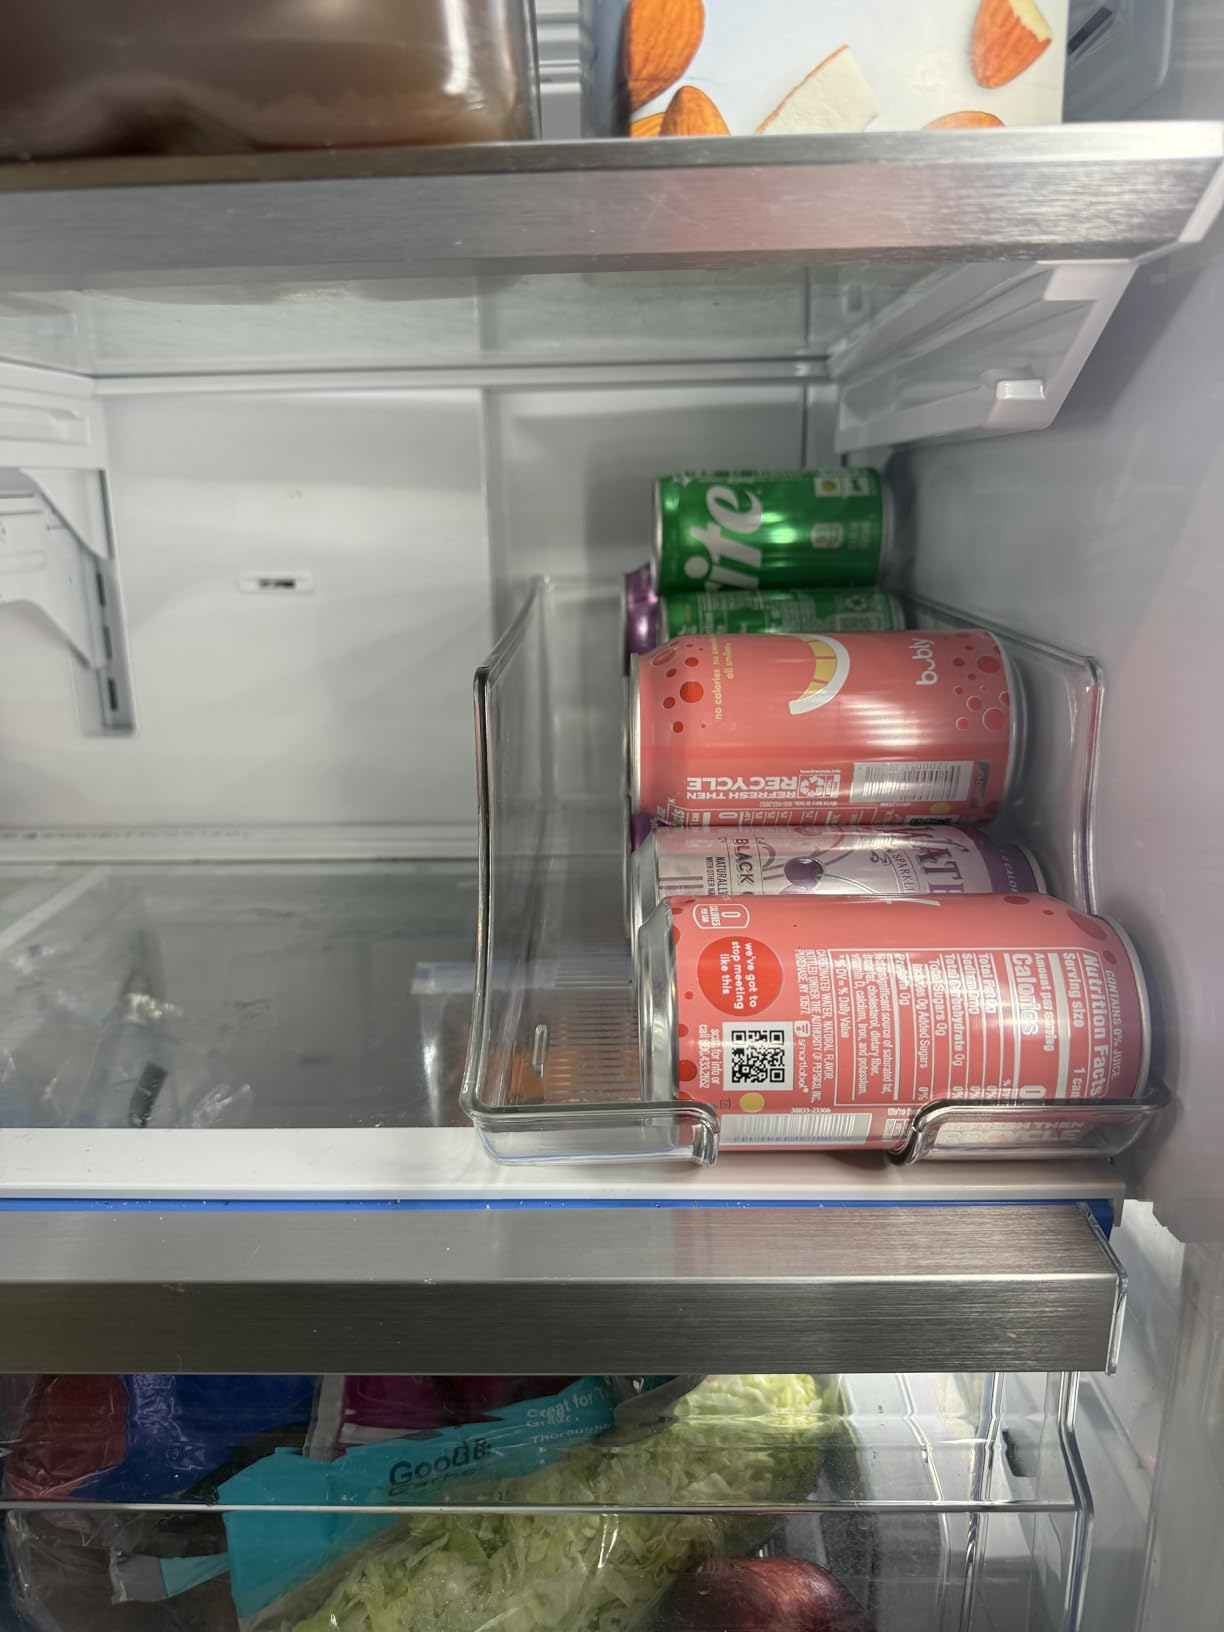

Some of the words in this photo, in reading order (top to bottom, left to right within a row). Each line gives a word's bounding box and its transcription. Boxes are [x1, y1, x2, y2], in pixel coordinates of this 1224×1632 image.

[684, 486, 763, 593] ite
[908, 638, 938, 686] bubly
[711, 669, 721, 705] calories
[687, 776, 798, 791] RECYCLE
[687, 792, 725, 800] THEN
[729, 792, 798, 800] REFRESH
[734, 839, 754, 886] BLACK
[707, 870, 716, 887] OTHER
[710, 905, 721, 926] CALORIES
[719, 954, 730, 972] like
[730, 941, 741, 962] stop
[744, 942, 757, 971] we've
[804, 949, 818, 975] BOTTLED
[816, 949, 832, 991] CARBONATED
[835, 969, 847, 979] DV
[893, 954, 912, 990] Protein
[928, 959, 944, 984] Total
[944, 953, 961, 979] Total
[962, 953, 979, 990] Sodium
[978, 953, 995, 978] Total
[721, 975, 731, 994] this
[732, 964, 745, 1009] meeting
[745, 974, 757, 993] got
[798, 984, 809, 993] NY
[807, 976, 820, 999] UNDER
[854, 981, 866, 989] D,
[1012, 953, 1041, 1035] Calories
[1063, 953, 1083, 998] Serving
[1073, 1001, 1085, 1028] size
[748, 996, 758, 1007] to
[809, 1000, 821, 1013] THE
[838, 996, 850, 1015] Daily
[856, 990, 868, 1022] calcium,
[867, 985, 881, 1029] cholesterol,
[899, 992, 911, 1005] 0g
[915, 998, 929, 1009] 0g
[932, 984, 947, 1020] Sugars
[968, 991, 983, 1014] 0mg
[1034, 953, 1052, 990] Amount
[1043, 1011, 1057, 1051] serving
[1083, 954, 1108, 1039] Nutrition
[1106, 970, 1121, 1024] CONTAINS
[881, 1013, 892, 1038] source
[918, 1011, 930, 1038] Added
[949, 980, 965, 1051] Carbohydrate
[698, 1024, 709, 1038] call
[710, 1029, 720, 1047] scan
[811, 1014, 823, 1051] AUTHORITY
[822, 1021, 833, 1051] NATURAL
[839, 1017, 851, 1038] Value
[858, 1023, 869, 1041] iron,
[935, 1023, 947, 1036] 0g
[1112, 1028, 1121, 1045] 0%
[711, 1049, 721, 1059] for
[859, 1042, 869, 1056] and
[869, 1031, 881, 1056] dietary
[883, 1040, 893, 1048] of
[918, 1039, 931, 1069] Sugars
[698, 1039, 710, 1088] 800.433.2652
[711, 1061, 722, 1076] info
[812, 1053, 823, 1061] OF
[883, 1049, 892, 1081] saturated
[952, 1054, 965, 1066] 0g
[1111, 1049, 1120, 1079] JUICE
[711, 1077, 721, 1085] or
[1090, 1044, 1109, 1097] Facts
[881, 1083, 892, 1094] fat,
[918, 1086, 929, 1100] 0%
[1019, 1085, 1046, 1099] 0
[1071, 1078, 1084, 1097] can
[390, 1440, 471, 1486] Good
